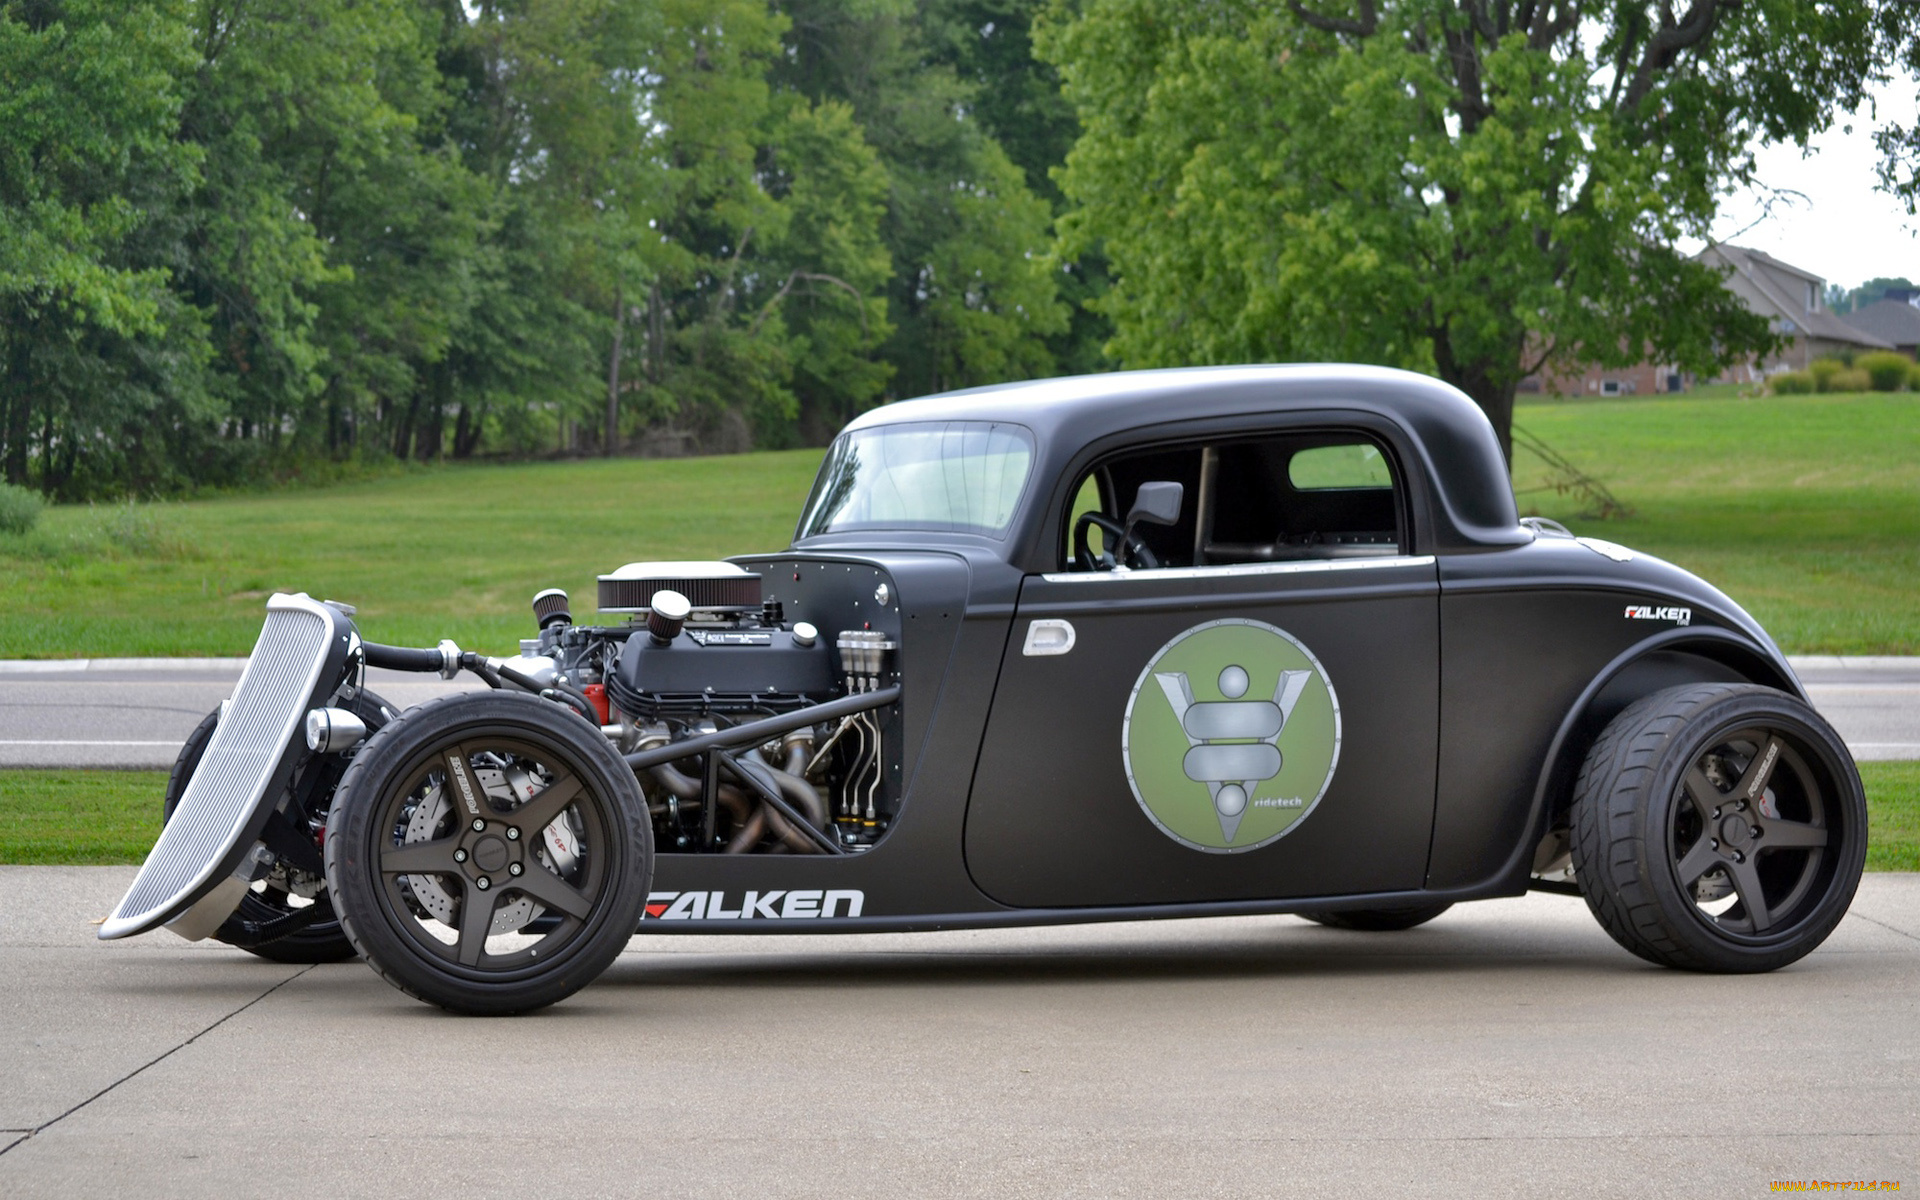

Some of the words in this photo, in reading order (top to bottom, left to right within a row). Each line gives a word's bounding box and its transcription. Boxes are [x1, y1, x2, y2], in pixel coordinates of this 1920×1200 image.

[1624, 605, 1691, 620] FALKEN
[1254, 796, 1302, 807] ridetech
[639, 890, 865, 920] FALKEN
